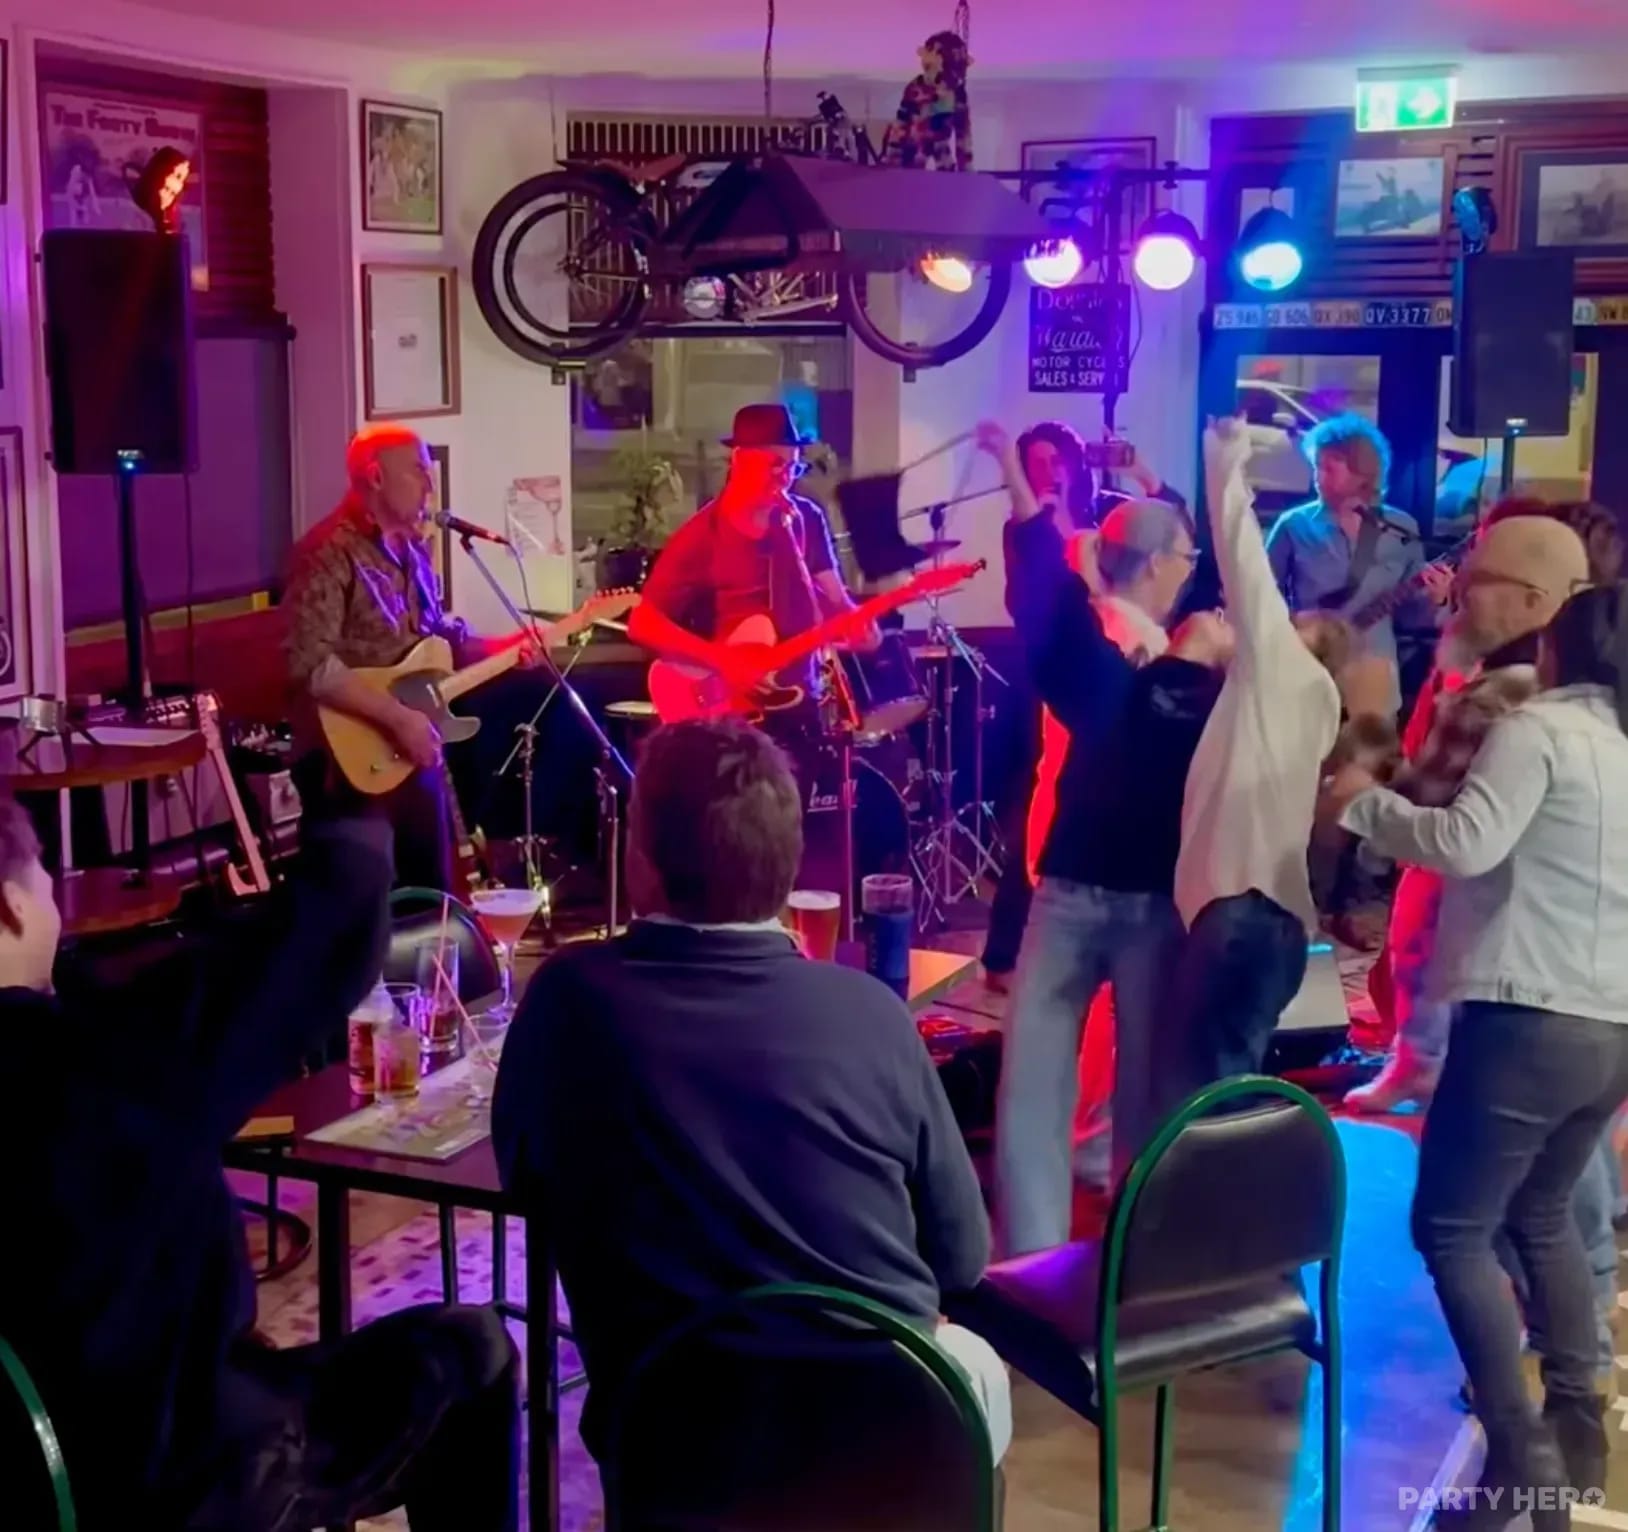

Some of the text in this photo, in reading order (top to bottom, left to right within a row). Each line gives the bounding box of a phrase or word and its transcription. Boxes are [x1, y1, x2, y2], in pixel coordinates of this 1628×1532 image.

[1032, 356, 1124, 369] MOTOR CYCS
[1035, 371, 1067, 386] SALES
